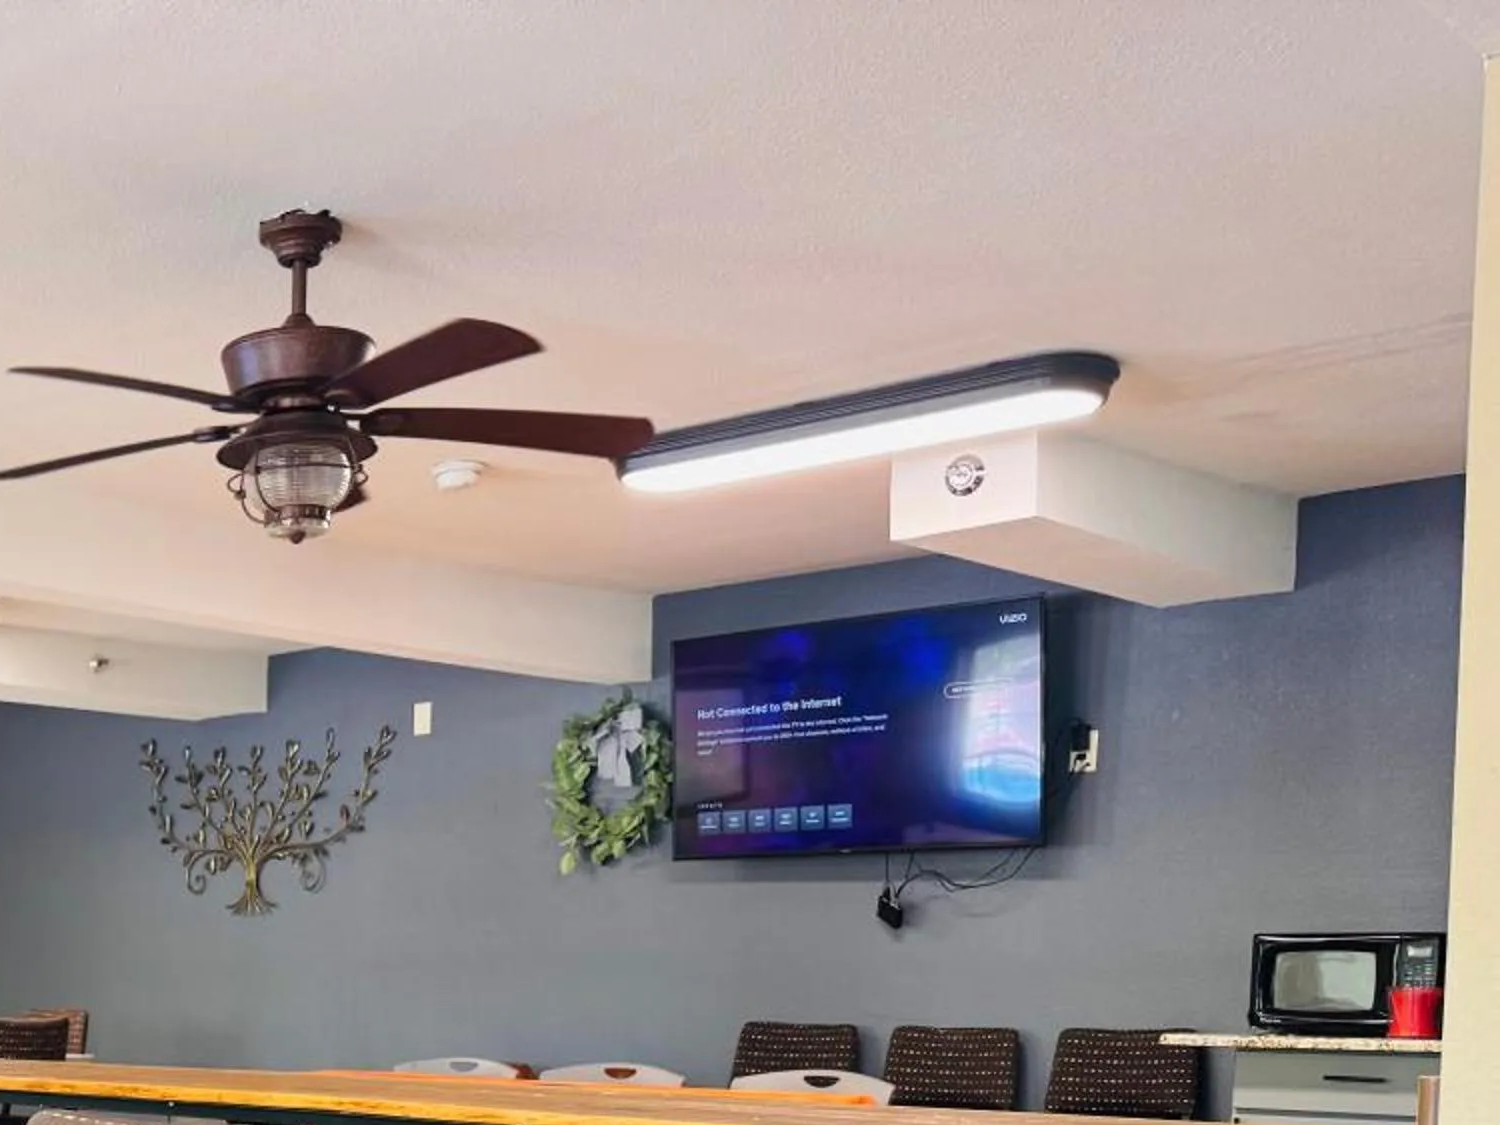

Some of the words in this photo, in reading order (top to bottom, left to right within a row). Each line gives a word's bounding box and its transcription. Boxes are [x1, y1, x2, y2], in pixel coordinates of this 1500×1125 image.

[697, 708, 715, 720] Not
[716, 705, 768, 718] Connected
[770, 702, 781, 713] to
[782, 700, 799, 712] the
[801, 696, 842, 710] Internet
